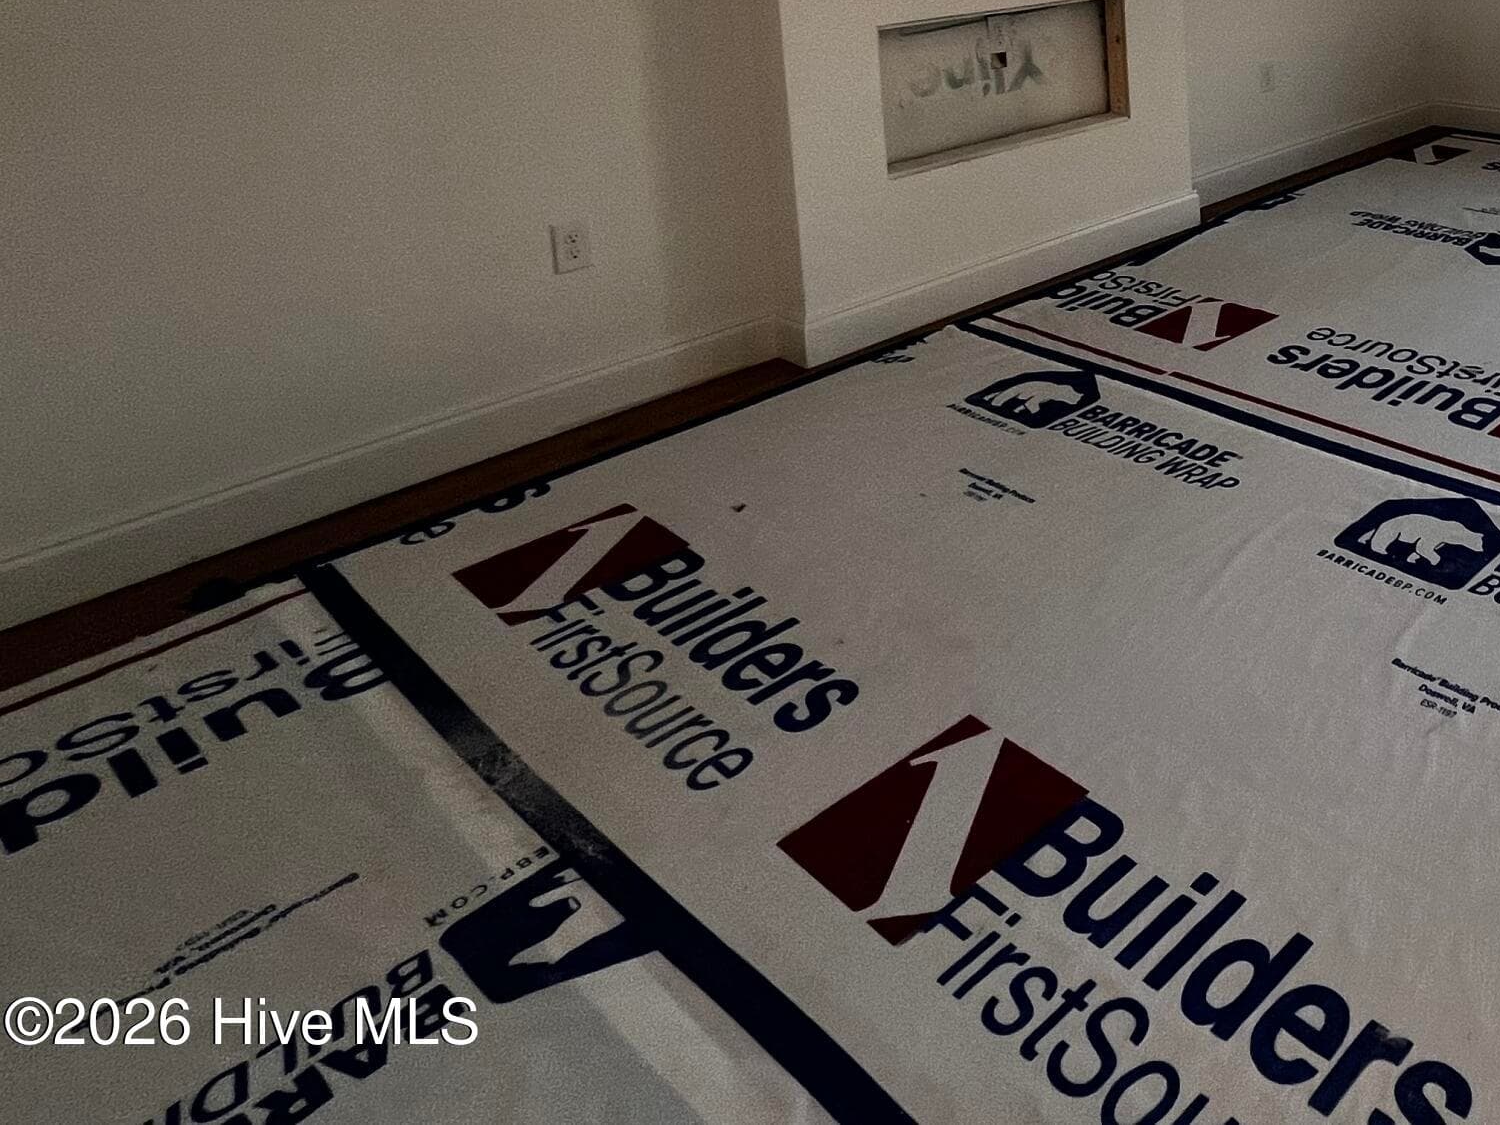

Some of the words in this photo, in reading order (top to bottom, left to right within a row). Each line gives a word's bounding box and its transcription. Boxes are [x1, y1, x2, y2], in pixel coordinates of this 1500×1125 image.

[1352, 217, 1472, 248] BARRICADE
[1088, 271, 1202, 308] FirstSo
[1048, 417, 1166, 464] BUILDING
[1155, 455, 1240, 491] WRAP
[1077, 404, 1240, 469] BARRICADE
[1315, 548, 1449, 606] BARRICADEBP.COM
[600, 547, 860, 734] Builders
[528, 594, 755, 792] FirstSource
[992, 797, 1473, 1125] Builders
